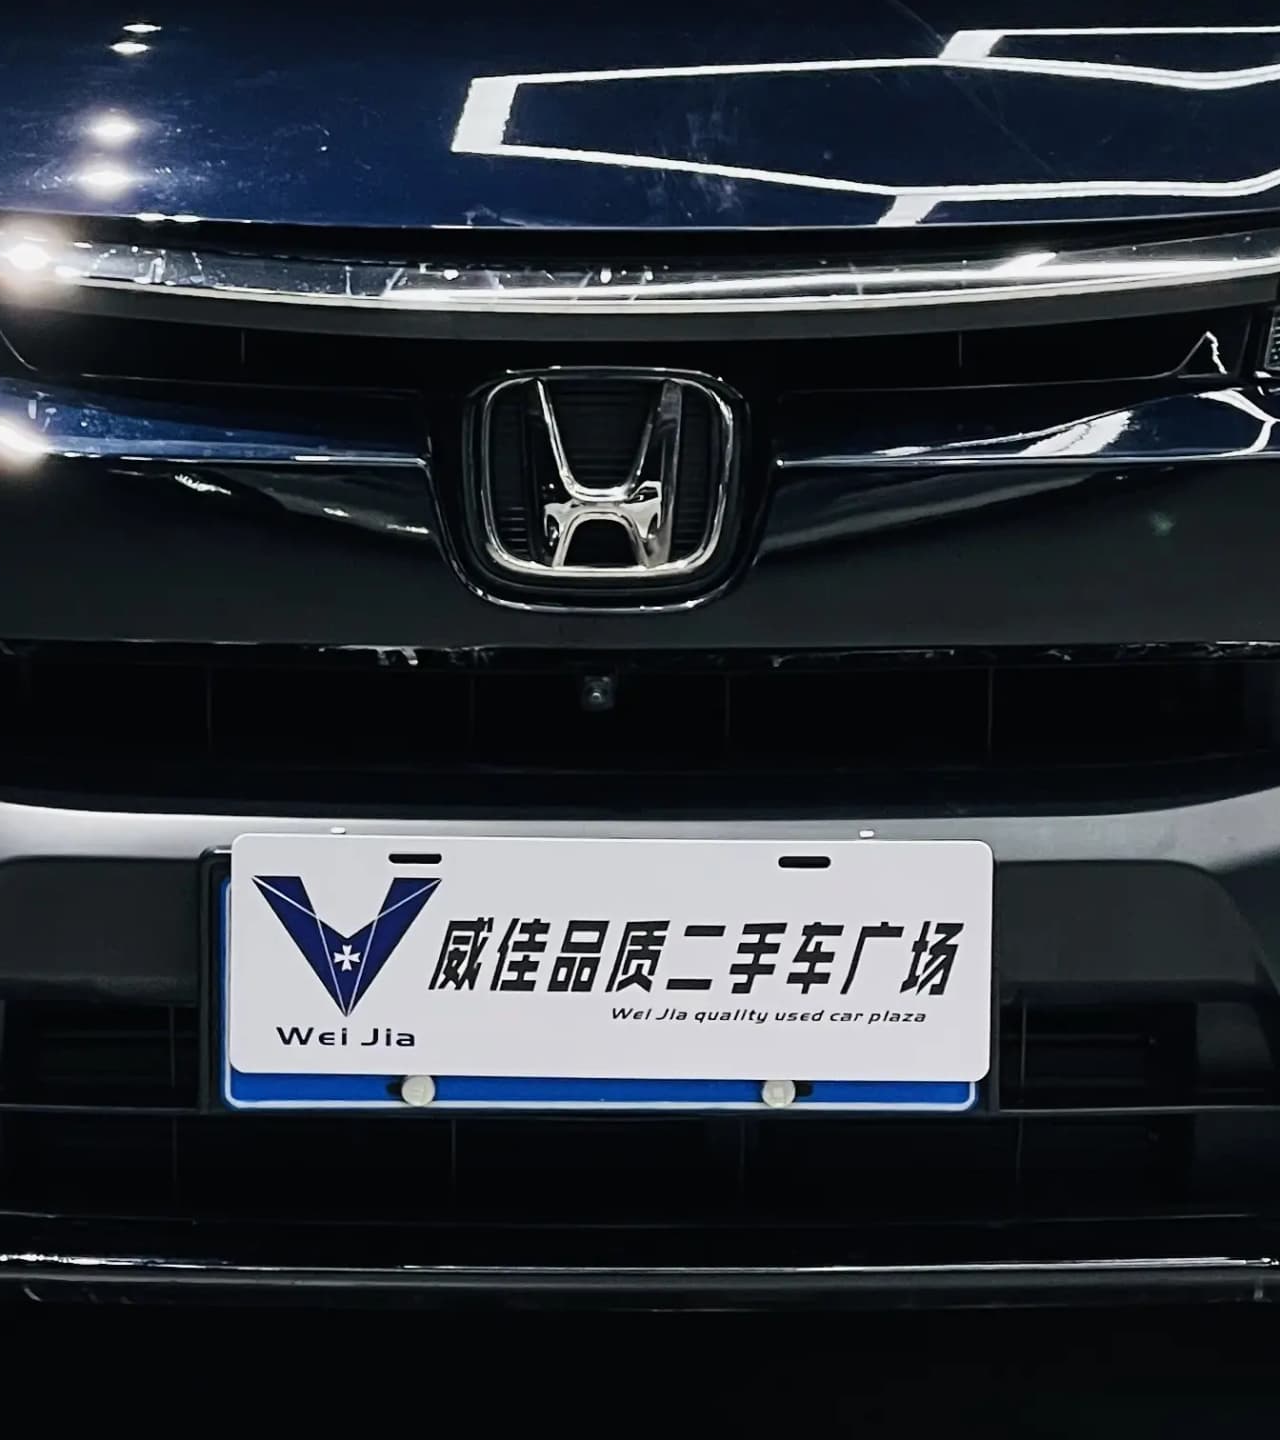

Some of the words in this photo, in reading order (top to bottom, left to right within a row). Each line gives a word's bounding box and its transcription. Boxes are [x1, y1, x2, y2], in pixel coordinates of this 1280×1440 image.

[427, 916, 965, 996] 威佳品质二手车广场
[611, 1007, 651, 1021] Wei
[655, 1008, 688, 1022] Jia
[694, 1008, 769, 1024] quality
[774, 1009, 824, 1022] used
[829, 1012, 864, 1022] car
[867, 1010, 927, 1025] plaza
[276, 1026, 348, 1046] Wei
[360, 1027, 416, 1047] Jia
